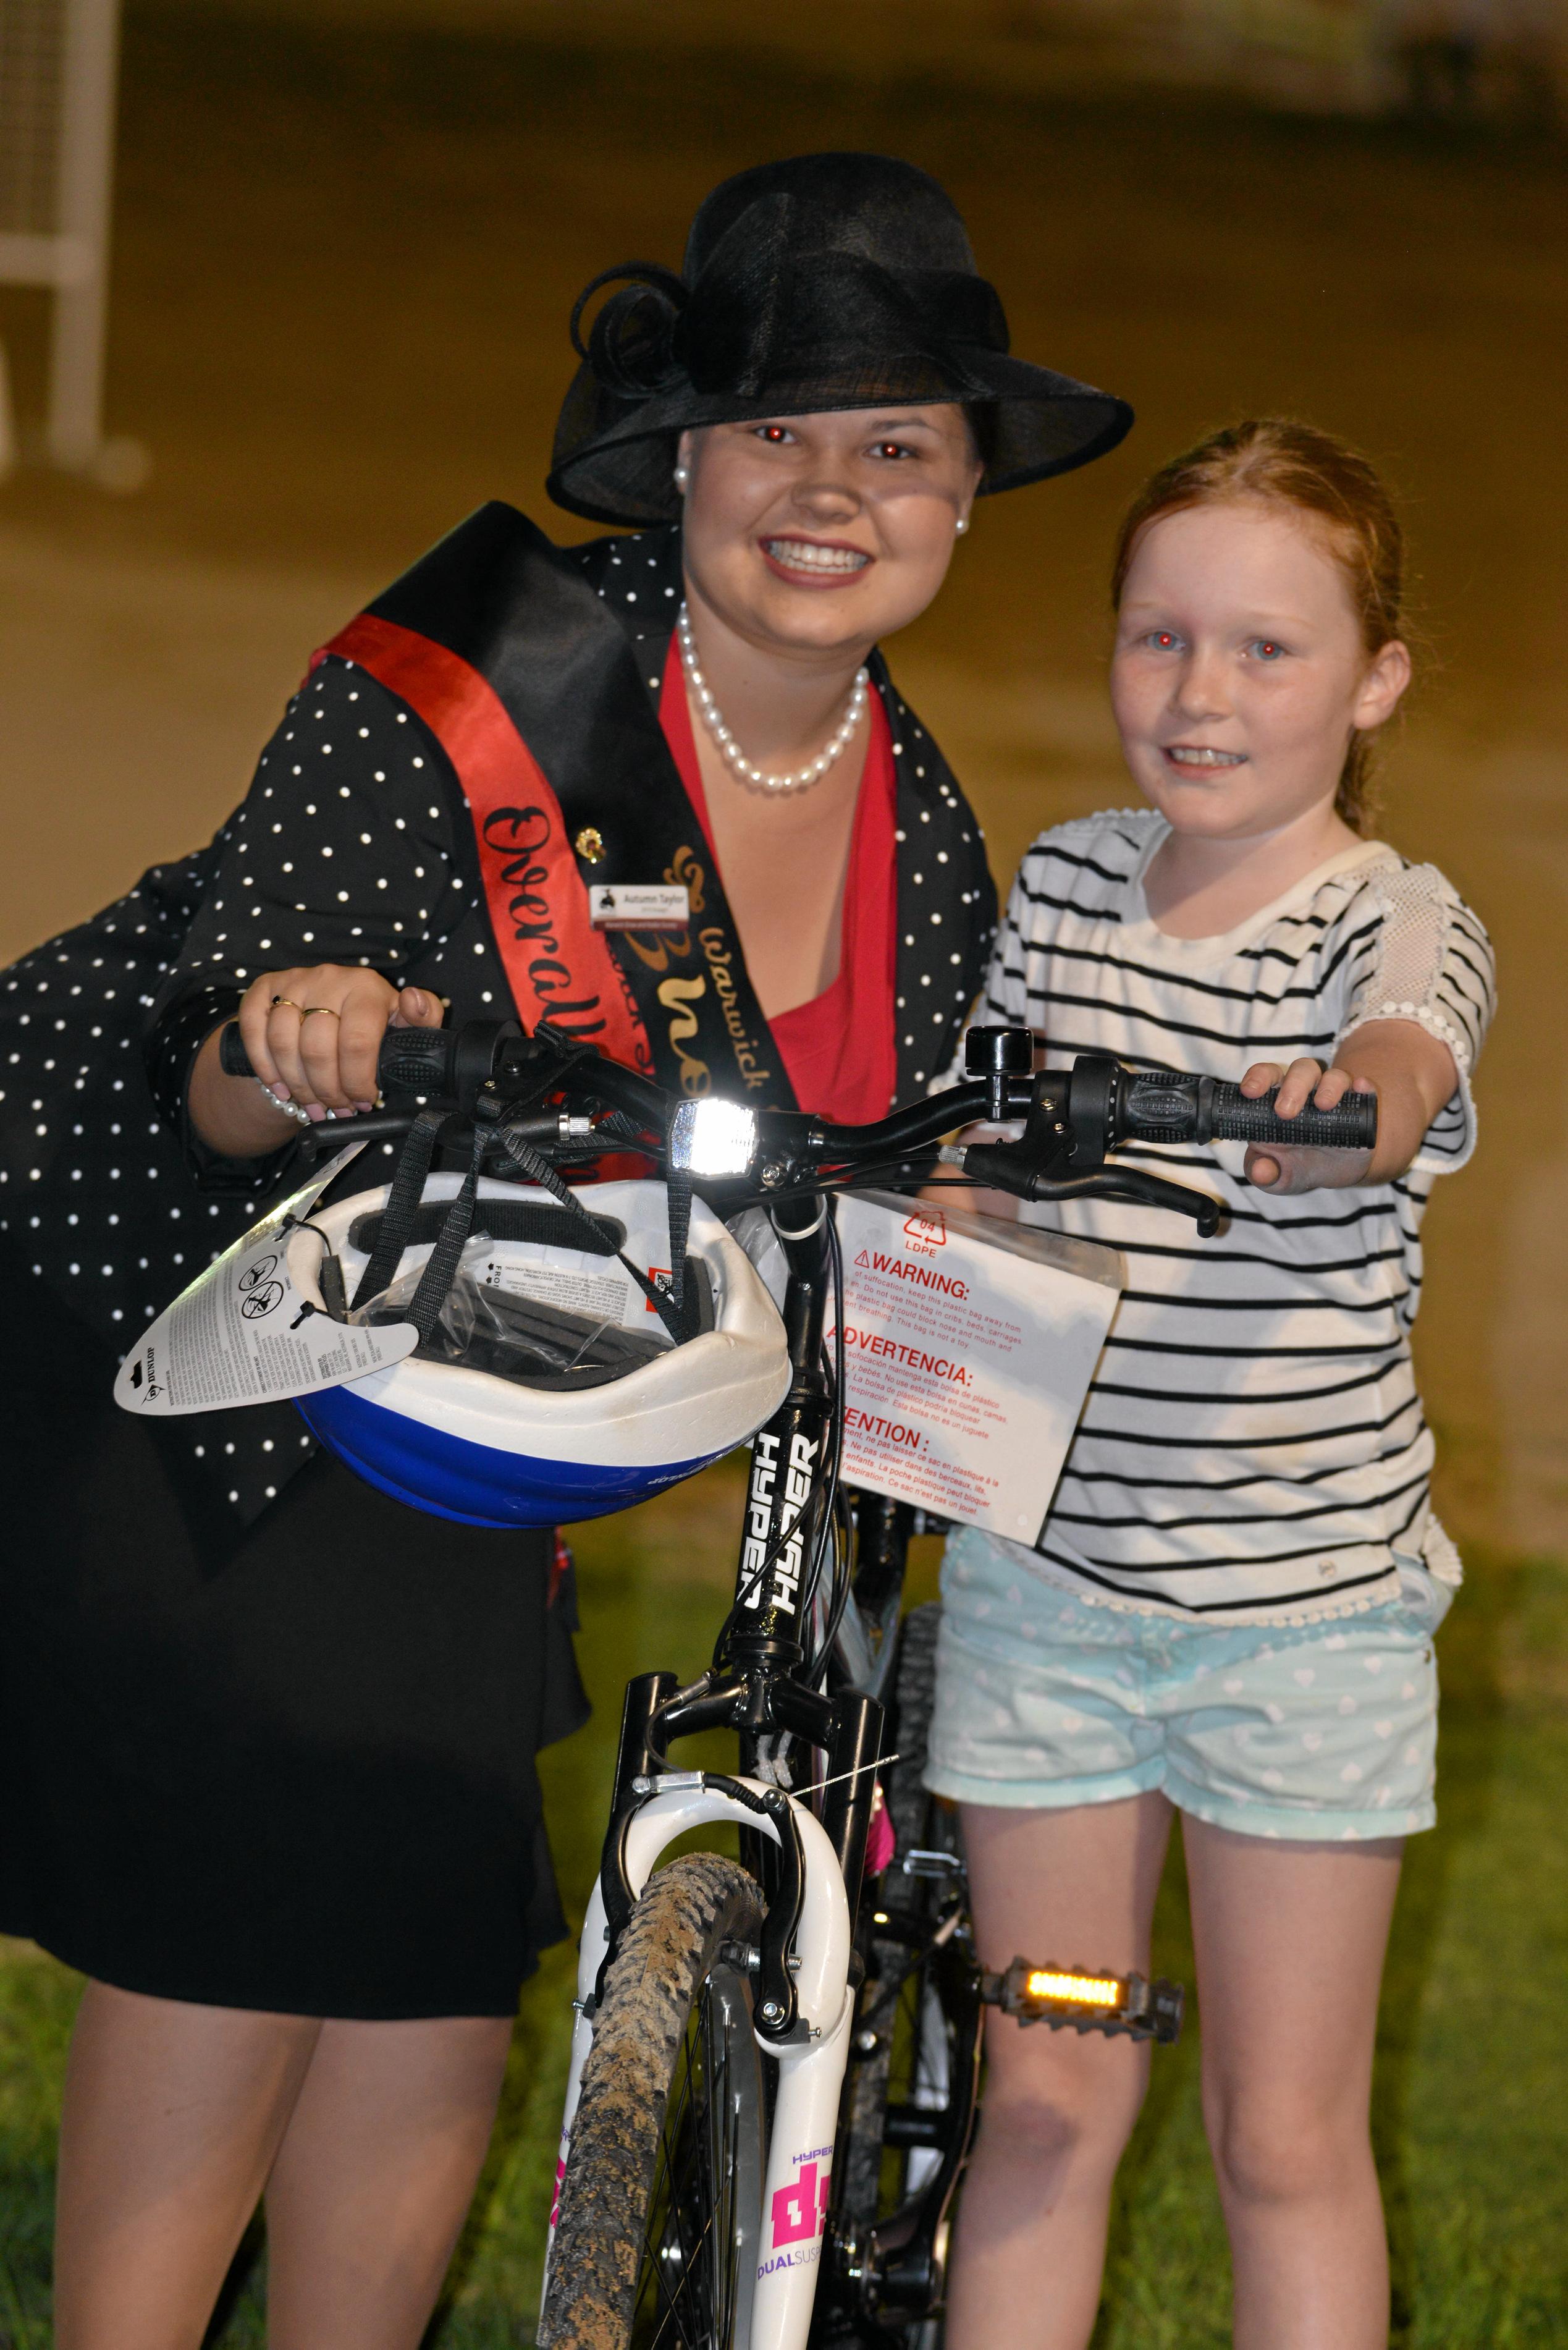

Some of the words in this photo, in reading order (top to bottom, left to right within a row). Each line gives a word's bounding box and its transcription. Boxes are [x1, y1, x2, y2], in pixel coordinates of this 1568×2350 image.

[483, 806, 607, 1036] Overall
[625, 894, 657, 904] Autumn
[659, 894, 684, 907] Taylor
[699, 927, 770, 1091] Warwick
[920, 1218, 935, 1232] 04
[905, 1240, 937, 1258] LDPE
[872, 1252, 970, 1301] WARNING:
[147, 1347, 155, 1384] DUNLOP
[827, 1325, 974, 1387] ADVERTENCIA:
[844, 1406, 922, 1448] ENTION
[737, 1432, 780, 1609] HYPER
[772, 1434, 819, 1615] HYPER
[793, 2145, 833, 2164] HYPER
[771, 2162, 830, 2249] d
[757, 2244, 822, 2280] DUALSUSP
